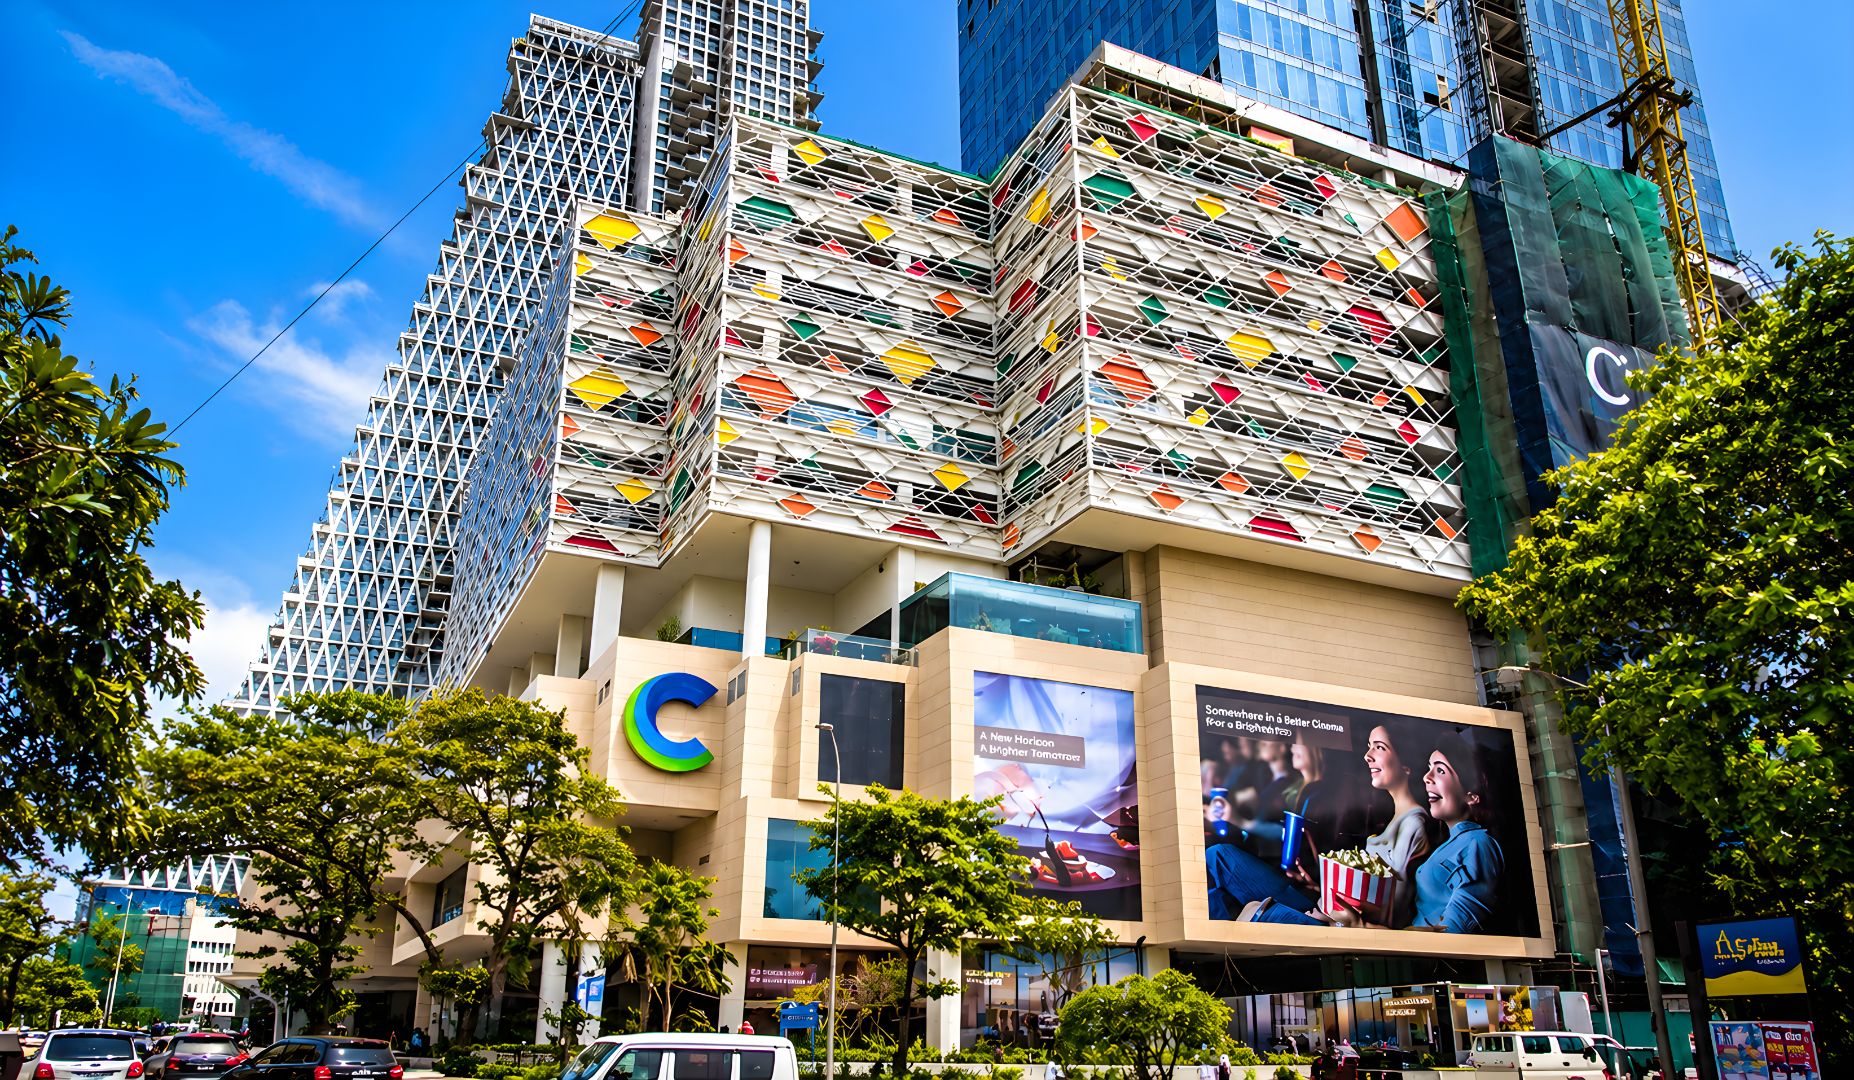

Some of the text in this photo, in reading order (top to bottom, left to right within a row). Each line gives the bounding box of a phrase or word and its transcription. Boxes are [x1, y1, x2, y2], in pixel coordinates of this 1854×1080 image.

[624, 672, 719, 772] C
[1265, 712, 1275, 722] in
[980, 731, 988, 741] A
[990, 732, 1013, 743] New
[980, 744, 988, 753] A
